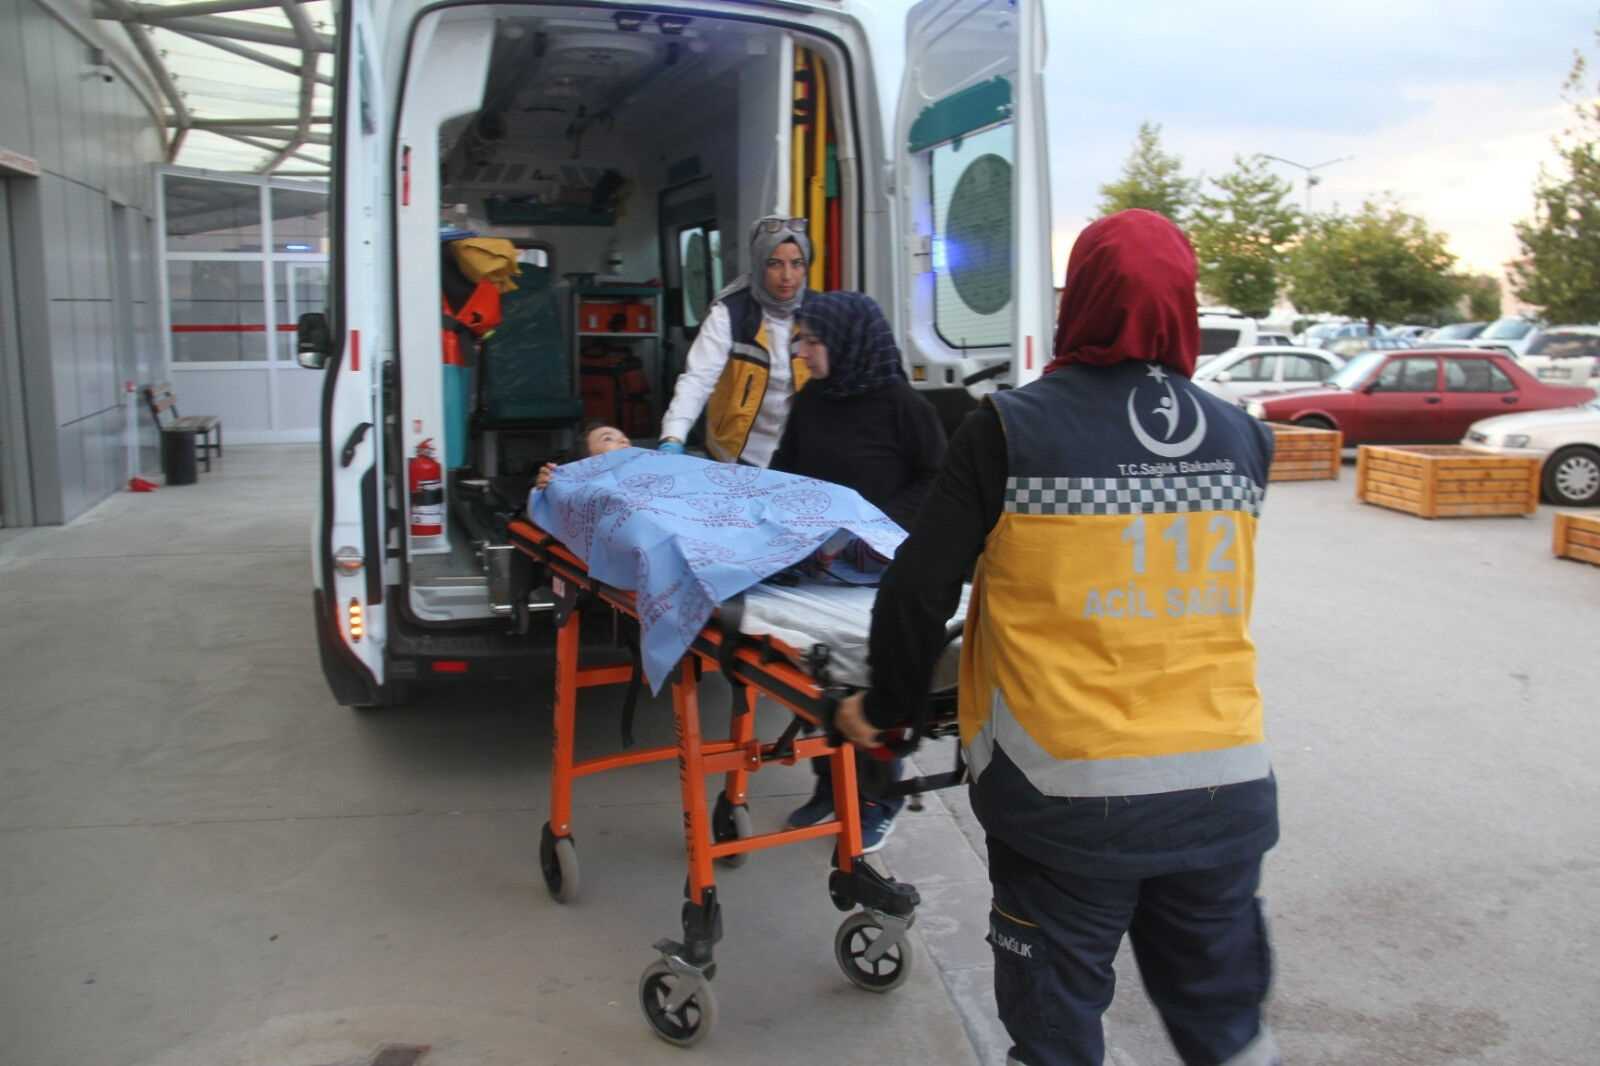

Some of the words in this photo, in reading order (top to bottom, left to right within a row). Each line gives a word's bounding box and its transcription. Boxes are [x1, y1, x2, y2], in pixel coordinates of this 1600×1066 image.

[1121, 515, 1237, 574] 112
[1082, 581, 1157, 618] ACİL
[1165, 580, 1244, 617] SAĞLI
[998, 934, 1032, 958] SAĞLIK
